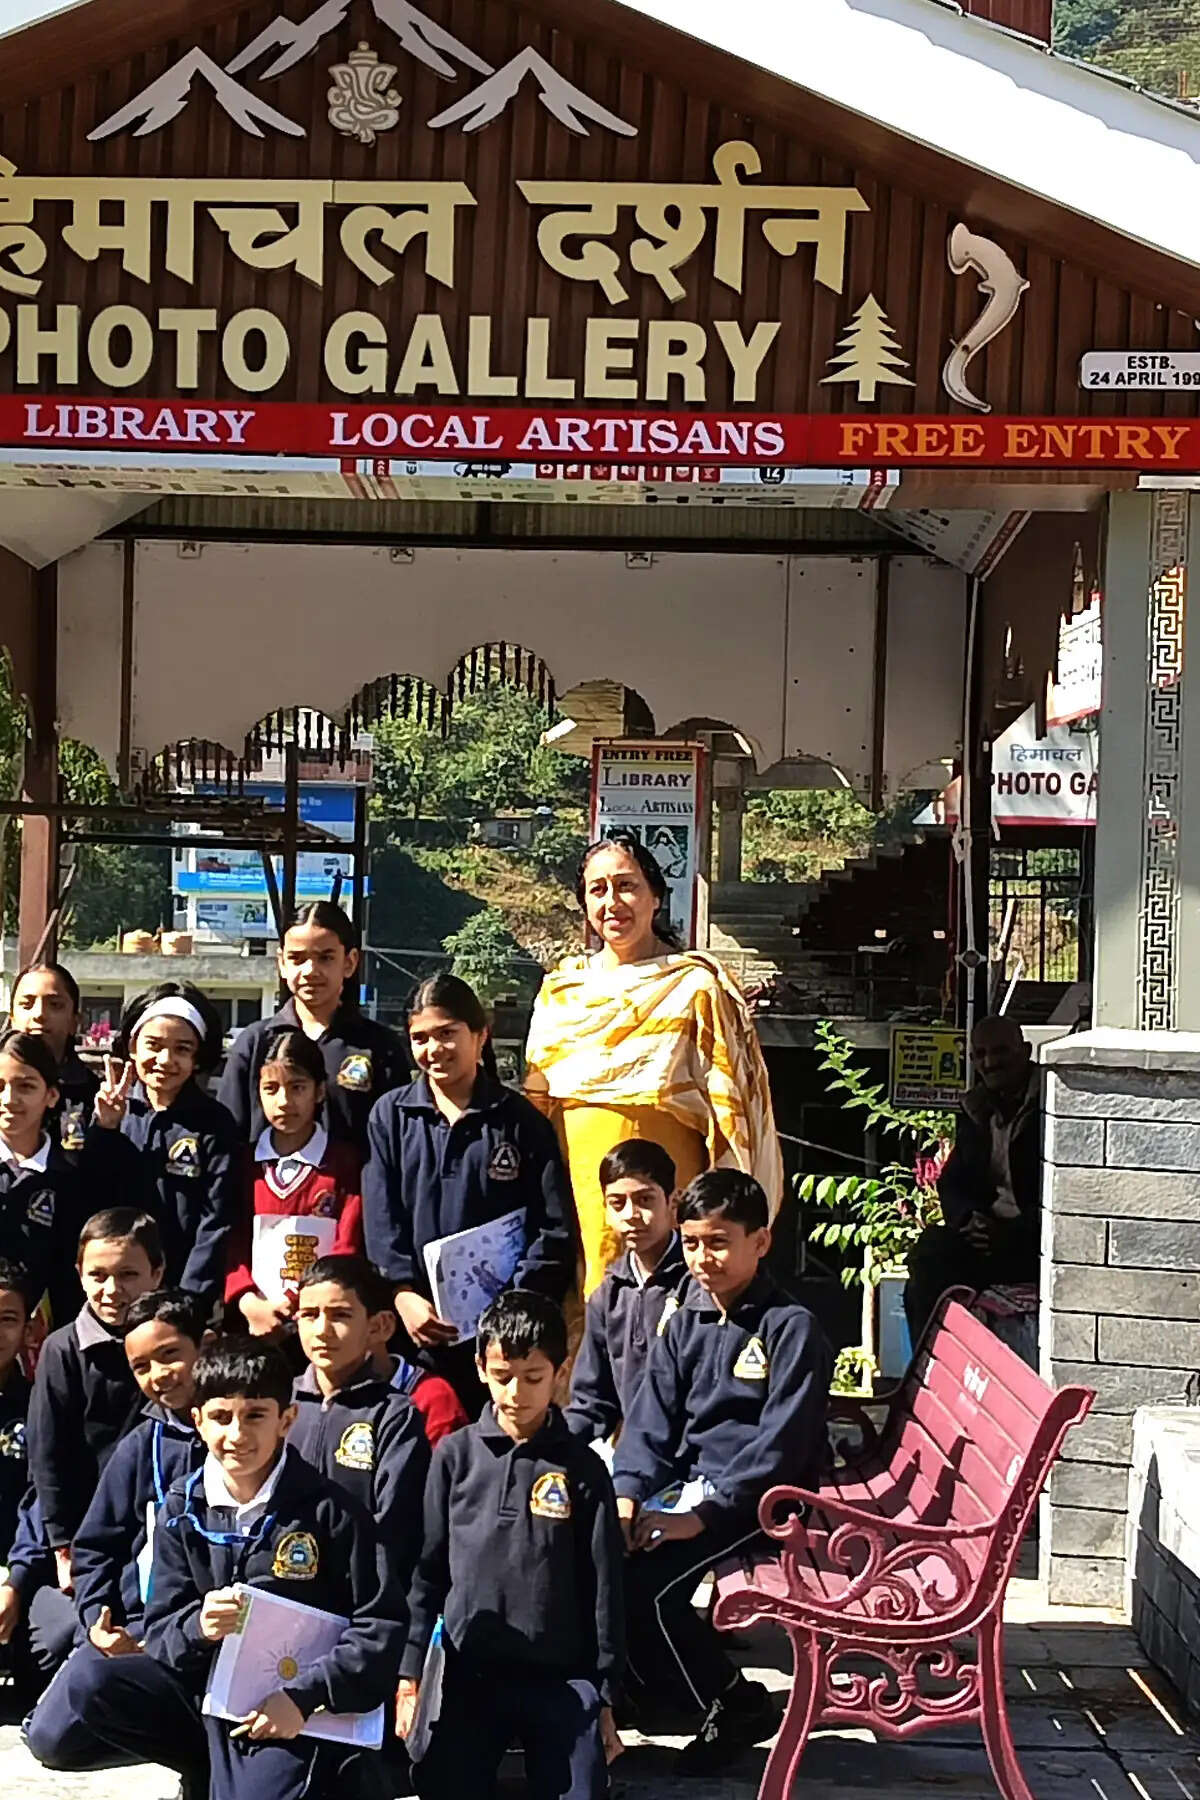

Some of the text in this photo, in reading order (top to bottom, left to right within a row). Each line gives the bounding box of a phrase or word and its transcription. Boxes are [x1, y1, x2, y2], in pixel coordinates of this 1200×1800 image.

[516, 140, 871, 304] दर्शन
[324, 310, 781, 402] GALLERY
[1127, 356, 1176, 369] ESTB.
[1089, 372, 1110, 385] 24
[1115, 372, 1167, 386] APRIL
[23, 403, 255, 444] LIBRARY
[329, 413, 785, 455] LOCAL ARTISANS
[840, 423, 1190, 460] FREE ENTRY
[602, 750, 693, 761] ENTRY FREE
[1010, 744, 1082, 762] हिमाचल
[603, 767, 691, 787] LIBRARY
